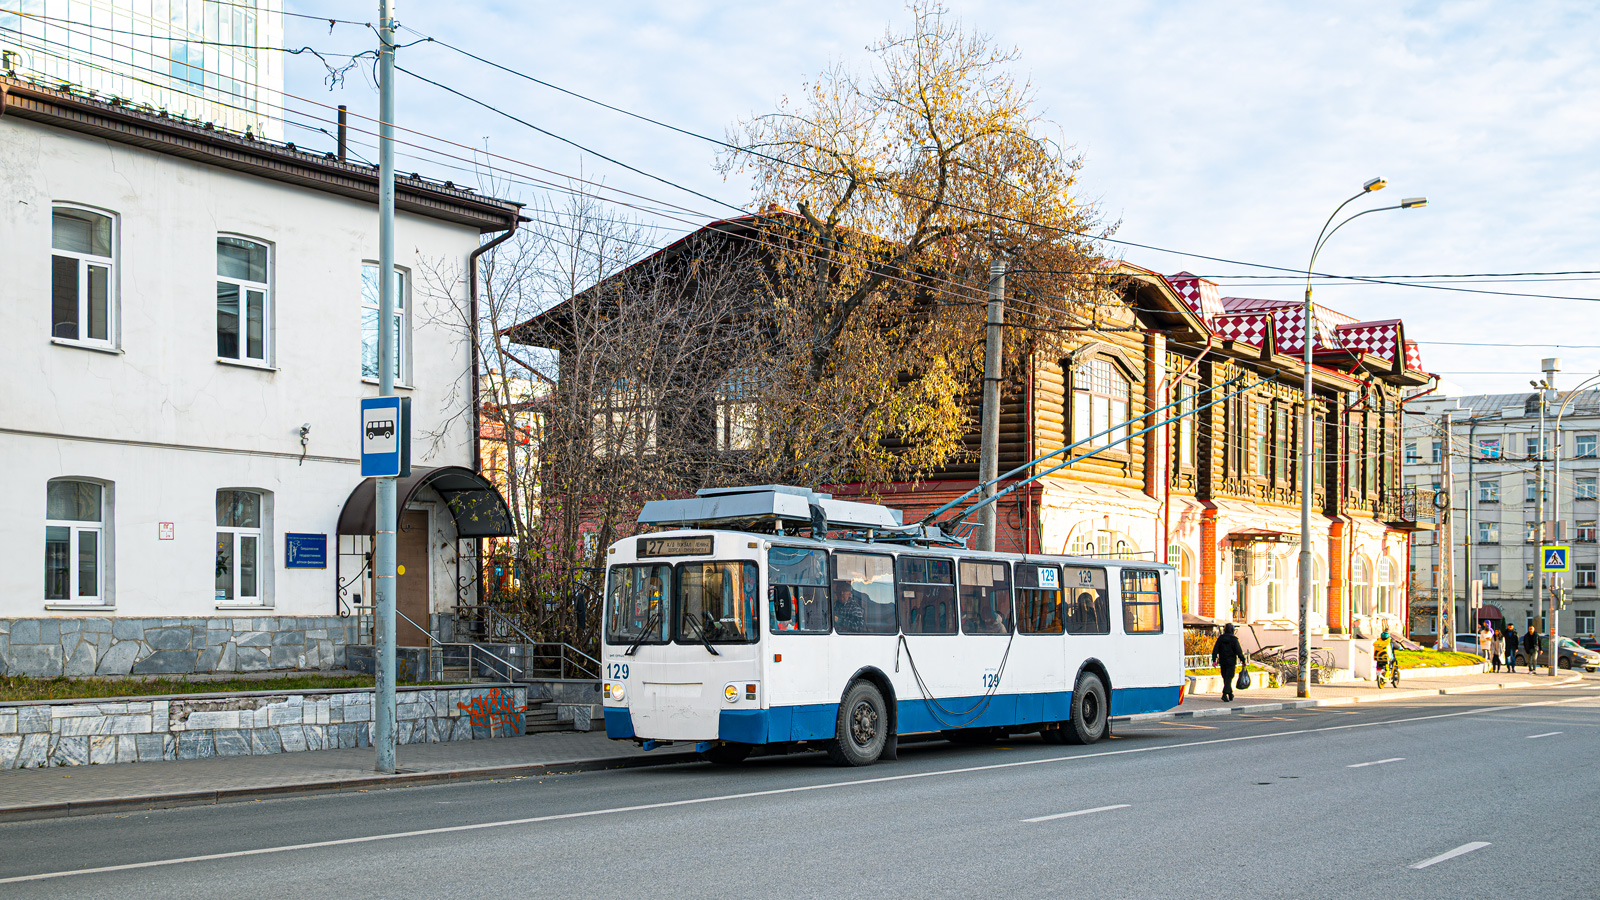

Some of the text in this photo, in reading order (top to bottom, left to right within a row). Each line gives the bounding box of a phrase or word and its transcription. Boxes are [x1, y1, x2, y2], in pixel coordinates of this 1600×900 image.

[649, 541, 665, 554] 27
[1041, 569, 1054, 582] 129
[1079, 570, 1092, 583] 129
[607, 663, 629, 679] 129
[982, 673, 999, 687] 129
